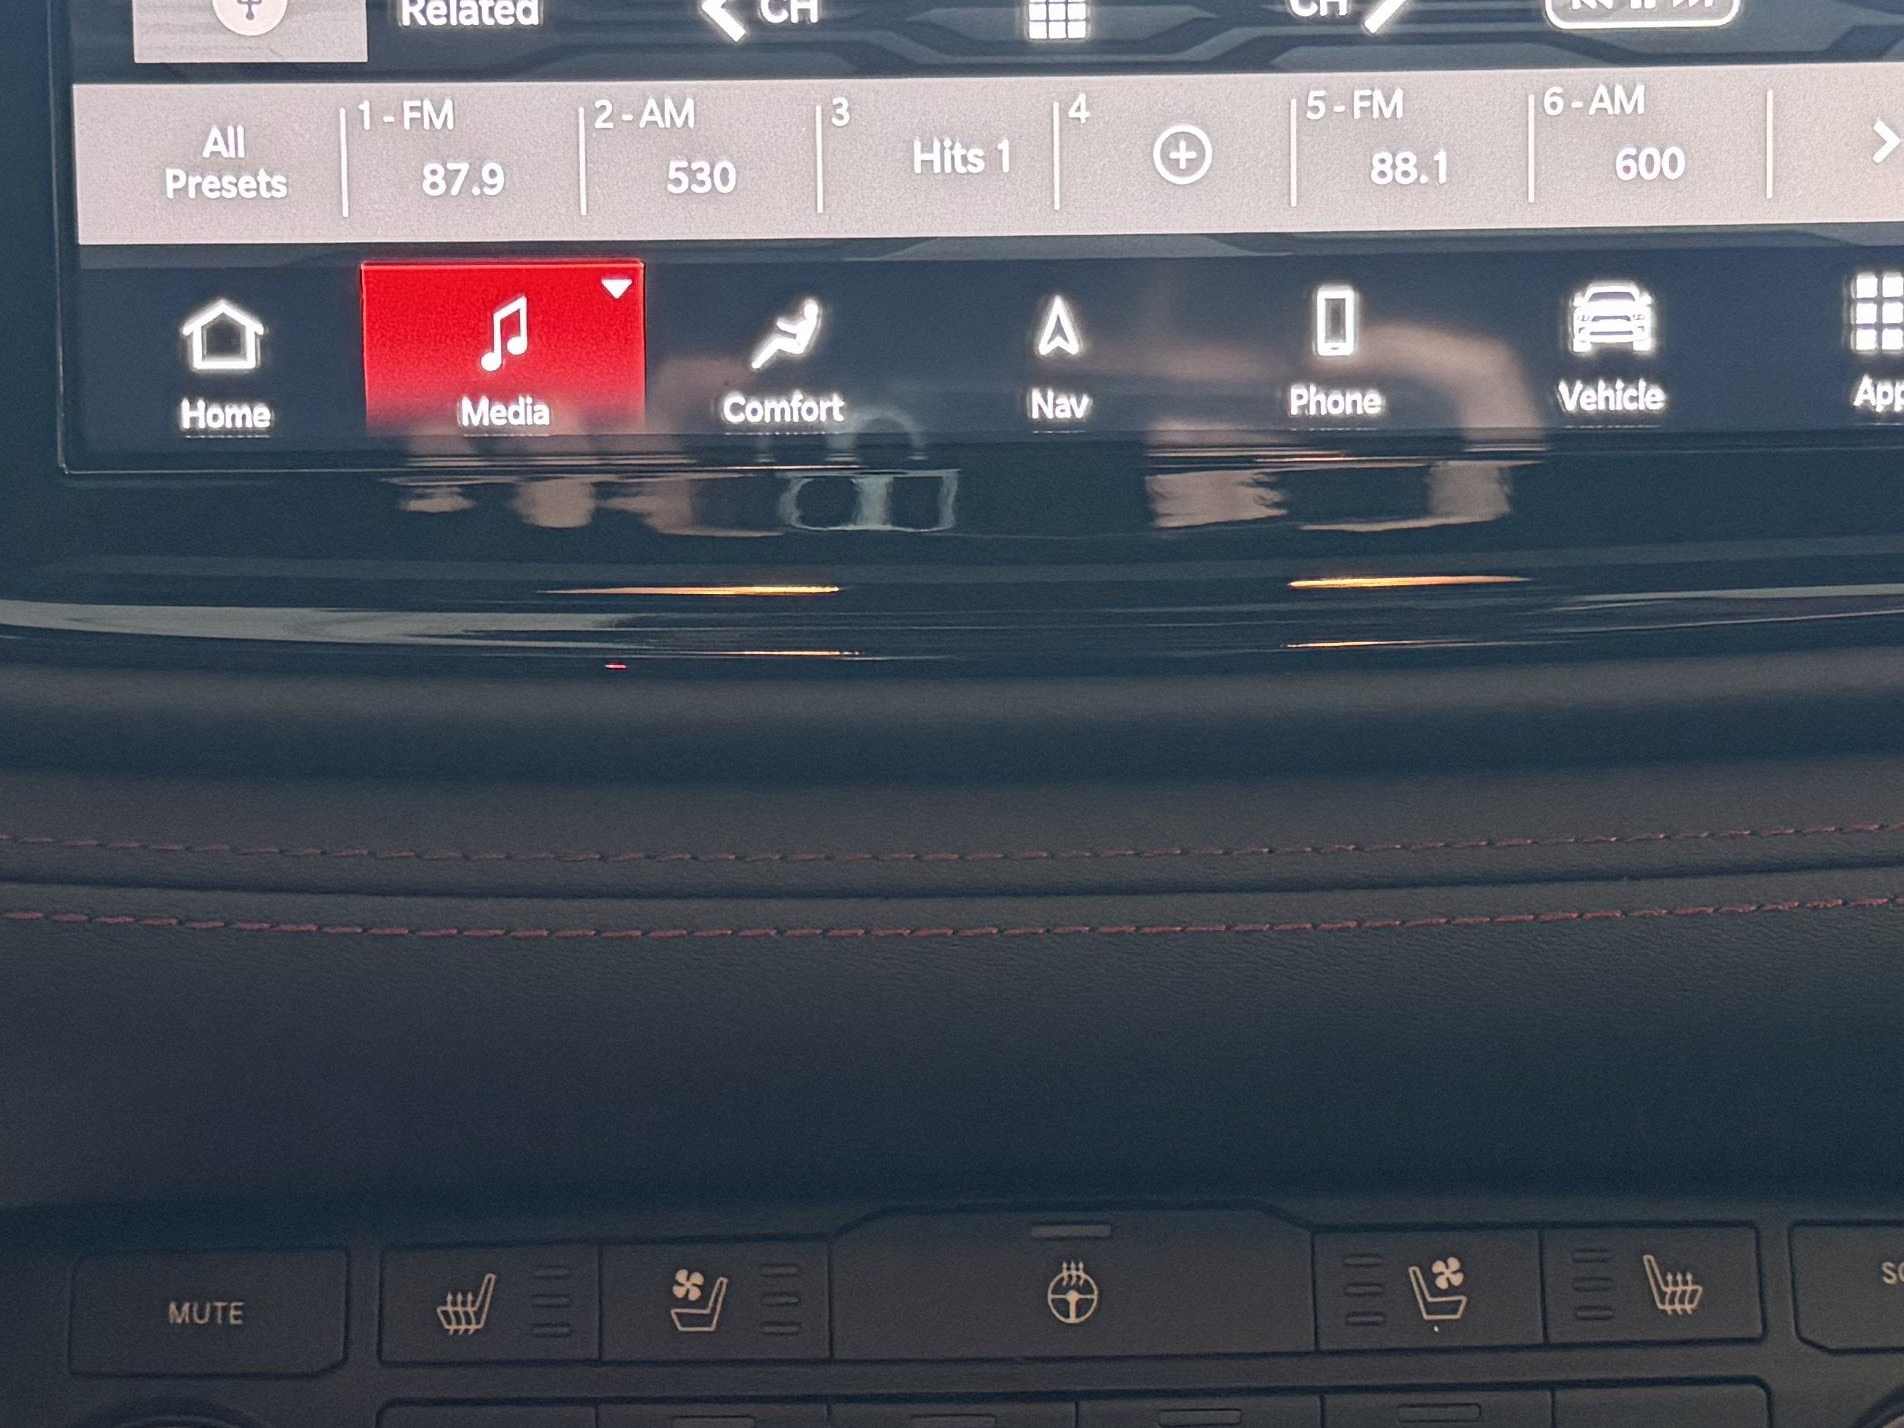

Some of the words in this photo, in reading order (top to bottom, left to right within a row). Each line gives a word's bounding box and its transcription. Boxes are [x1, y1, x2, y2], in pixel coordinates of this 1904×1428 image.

[831, 98, 850, 126] 3
[1069, 95, 1089, 123] 4
[202, 125, 245, 160] All
[913, 139, 984, 173] Hits
[997, 139, 1011, 172] 1
[421, 162, 505, 196] 87.9
[666, 160, 737, 194] 530
[1370, 151, 1448, 185] 88.1
[1615, 147, 1685, 181] 600
[165, 166, 288, 200] Presets
[460, 395, 550, 428] Media
[723, 392, 844, 424] Comfort
[1030, 389, 1089, 419] Nav
[1290, 385, 1381, 416] Phone
[1559, 381, 1664, 413] Vehicle
[181, 399, 271, 430] Home
[168, 1302, 244, 1326] MUTE
